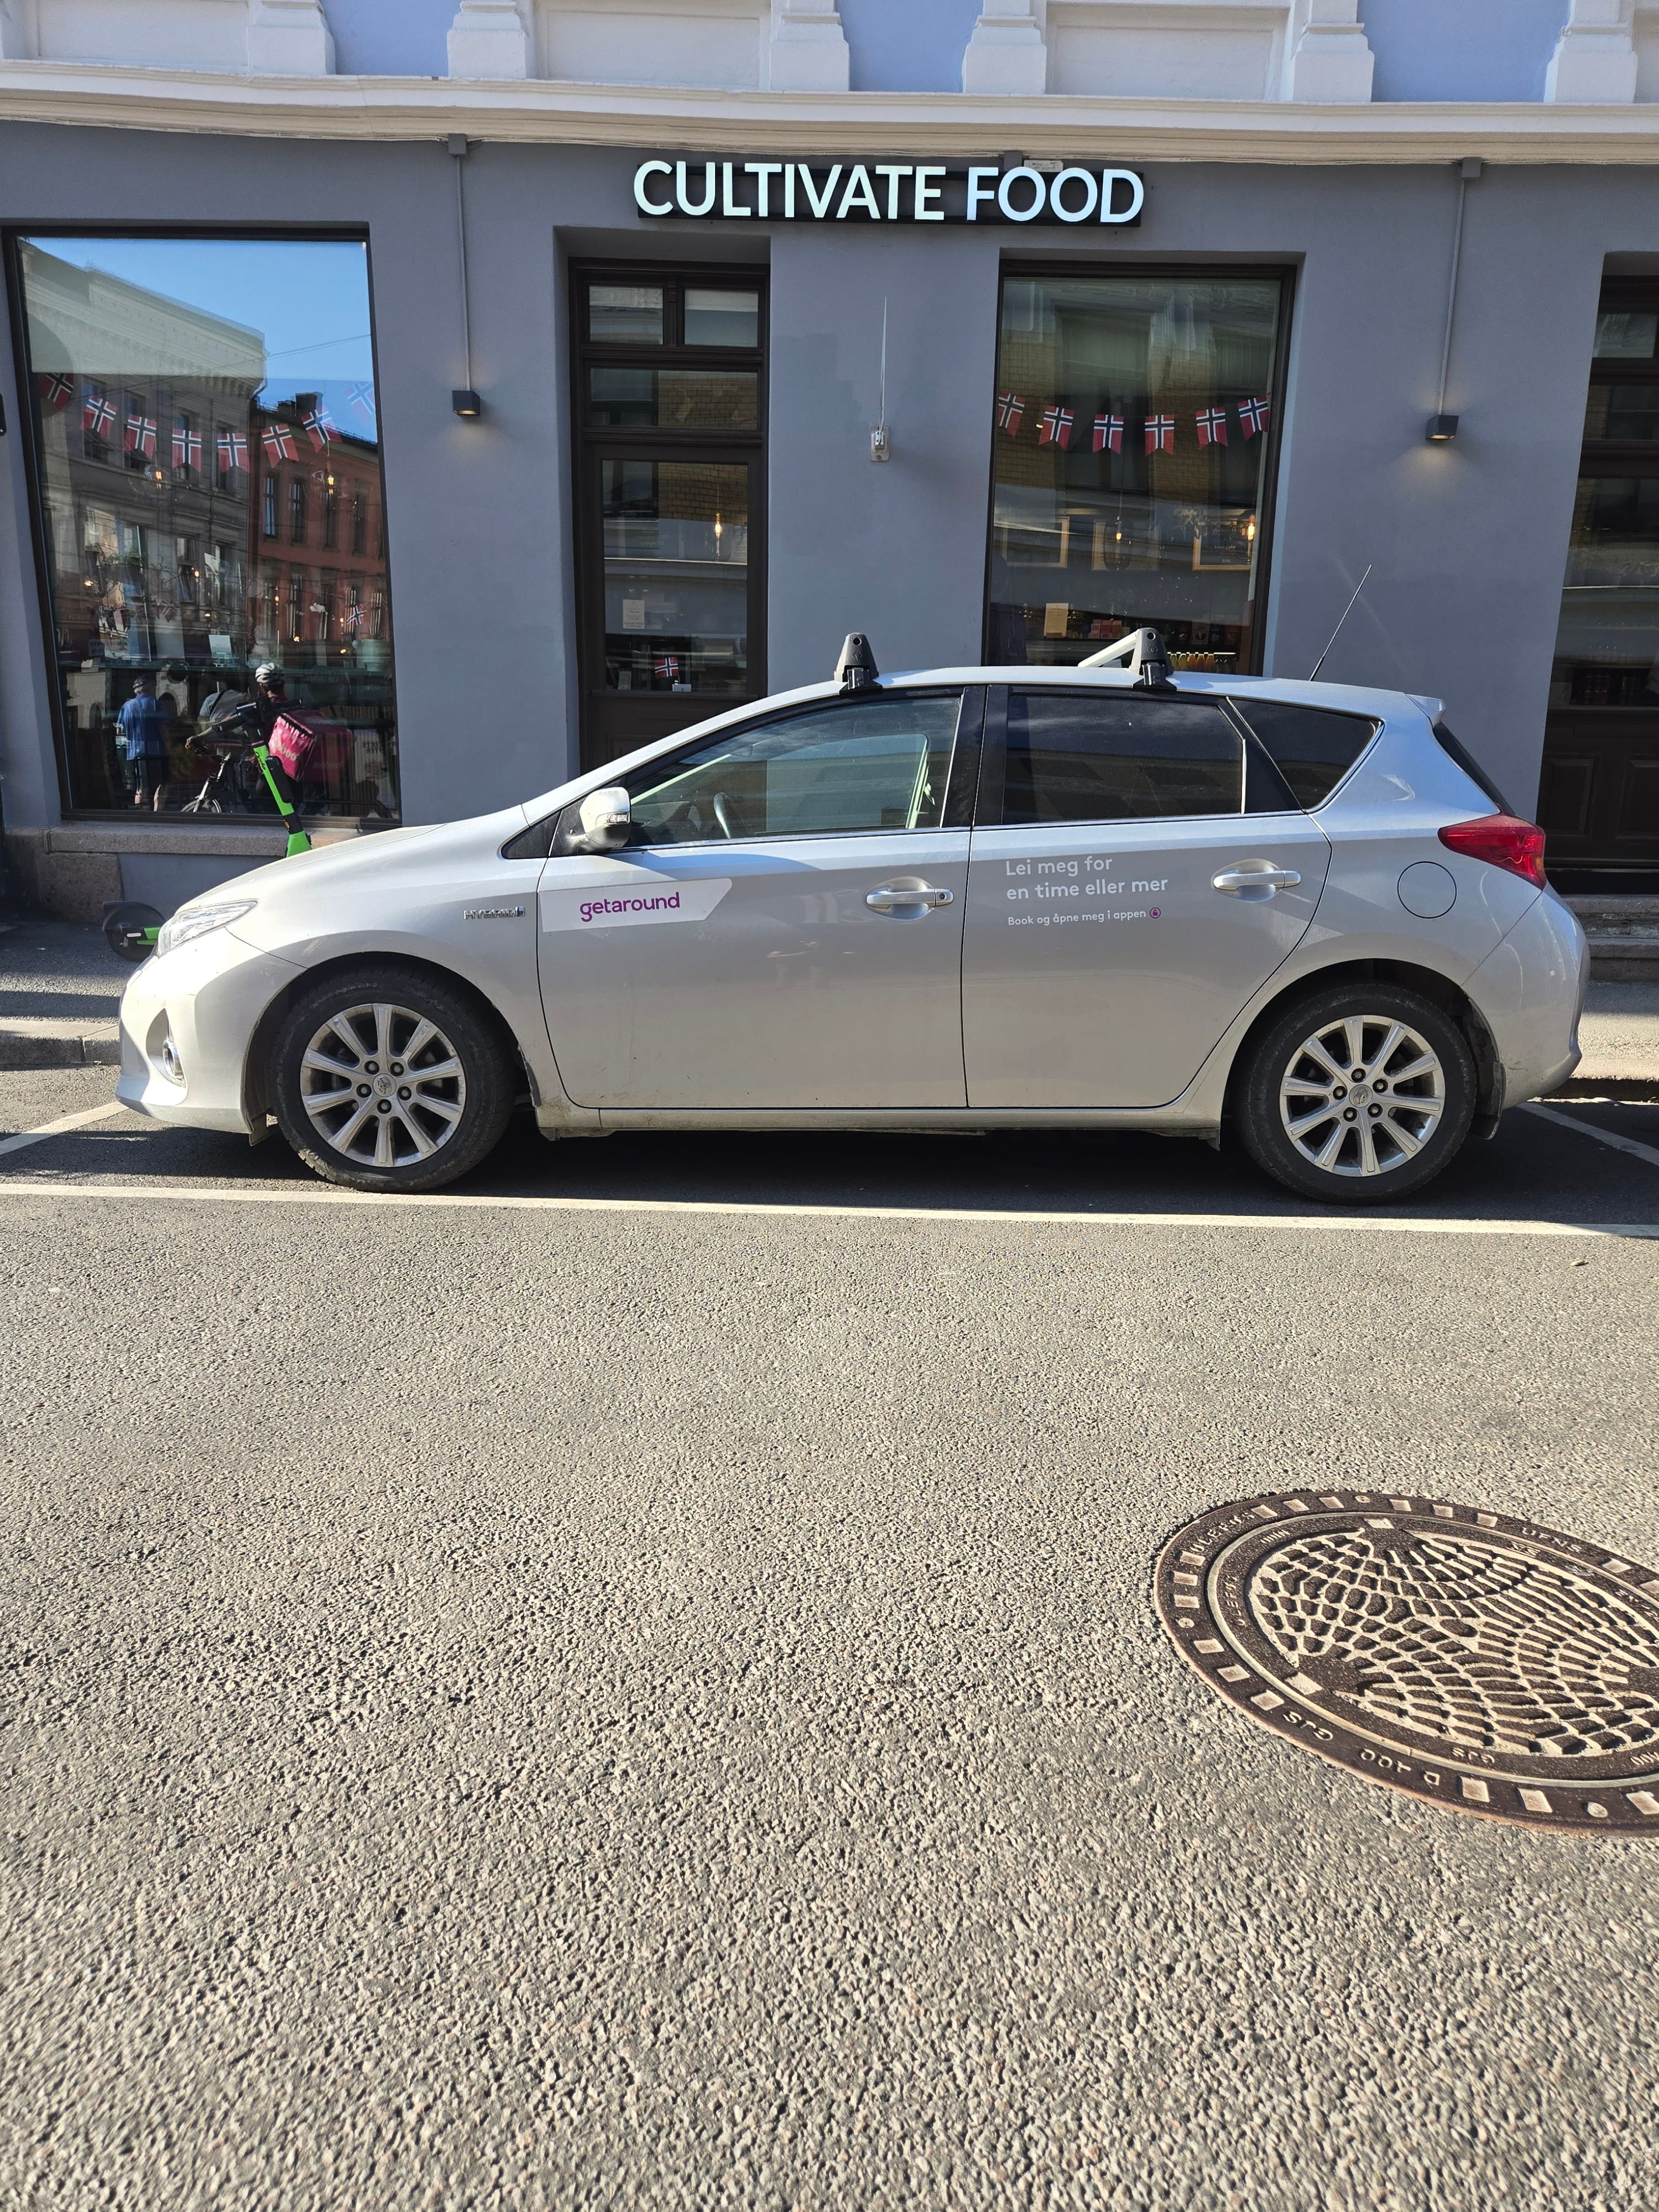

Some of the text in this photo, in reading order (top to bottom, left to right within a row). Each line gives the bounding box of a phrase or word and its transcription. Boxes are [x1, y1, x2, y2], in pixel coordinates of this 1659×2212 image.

[634, 160, 1144, 223] CULTIVATE FOOD
[1006, 856, 1113, 877] Lei meg for
[1006, 879, 1168, 900] en time eller mer
[463, 909, 515, 919] HYBRID
[580, 892, 680, 922] getaround
[1008, 910, 1146, 926] Book og åpne meg i appen
[1283, 1711, 1333, 1741] GJS
[1360, 1748, 1440, 1786] D 400
